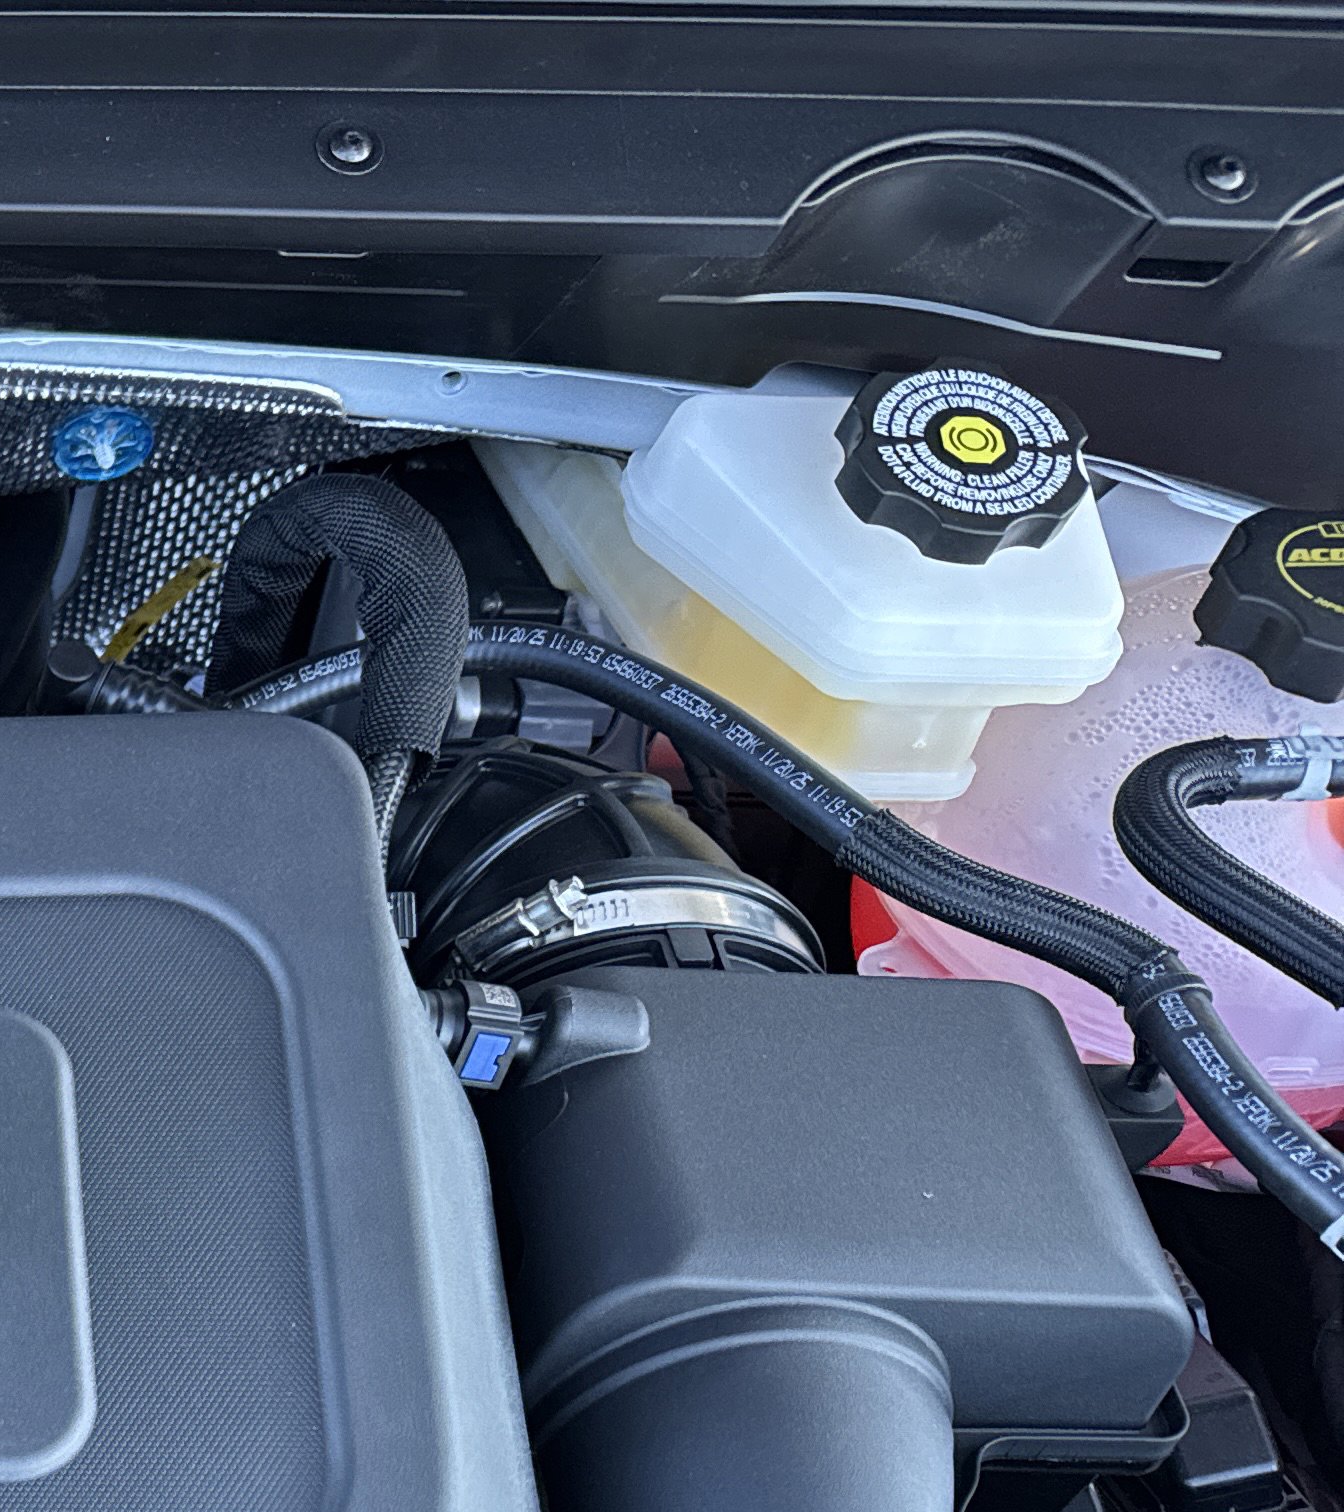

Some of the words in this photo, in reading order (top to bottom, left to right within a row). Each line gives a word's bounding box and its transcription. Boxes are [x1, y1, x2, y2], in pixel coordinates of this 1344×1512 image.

[940, 369, 957, 381] LE
[957, 370, 1012, 392] BOUCHON
[1008, 384, 1045, 411] AVANT
[995, 392, 1014, 407] DE
[877, 446, 901, 467] DOT
[896, 470, 935, 498] FLUID
[932, 491, 972, 511] FROM
[975, 502, 984, 514] A
[985, 495, 1036, 515] SEALED
[895, 444, 919, 465] CAP
[909, 462, 957, 494] BEFORE
[1030, 452, 1052, 478] ONLY
[966, 471, 1011, 487] CLEAN
[1004, 450, 1034, 480] FILLER
[491, 626, 548, 646] 11/20/25
[549, 632, 605, 664] 11:19:53
[759, 748, 813, 790] 11/20/25
[808, 784, 864, 827] 11:19:53
